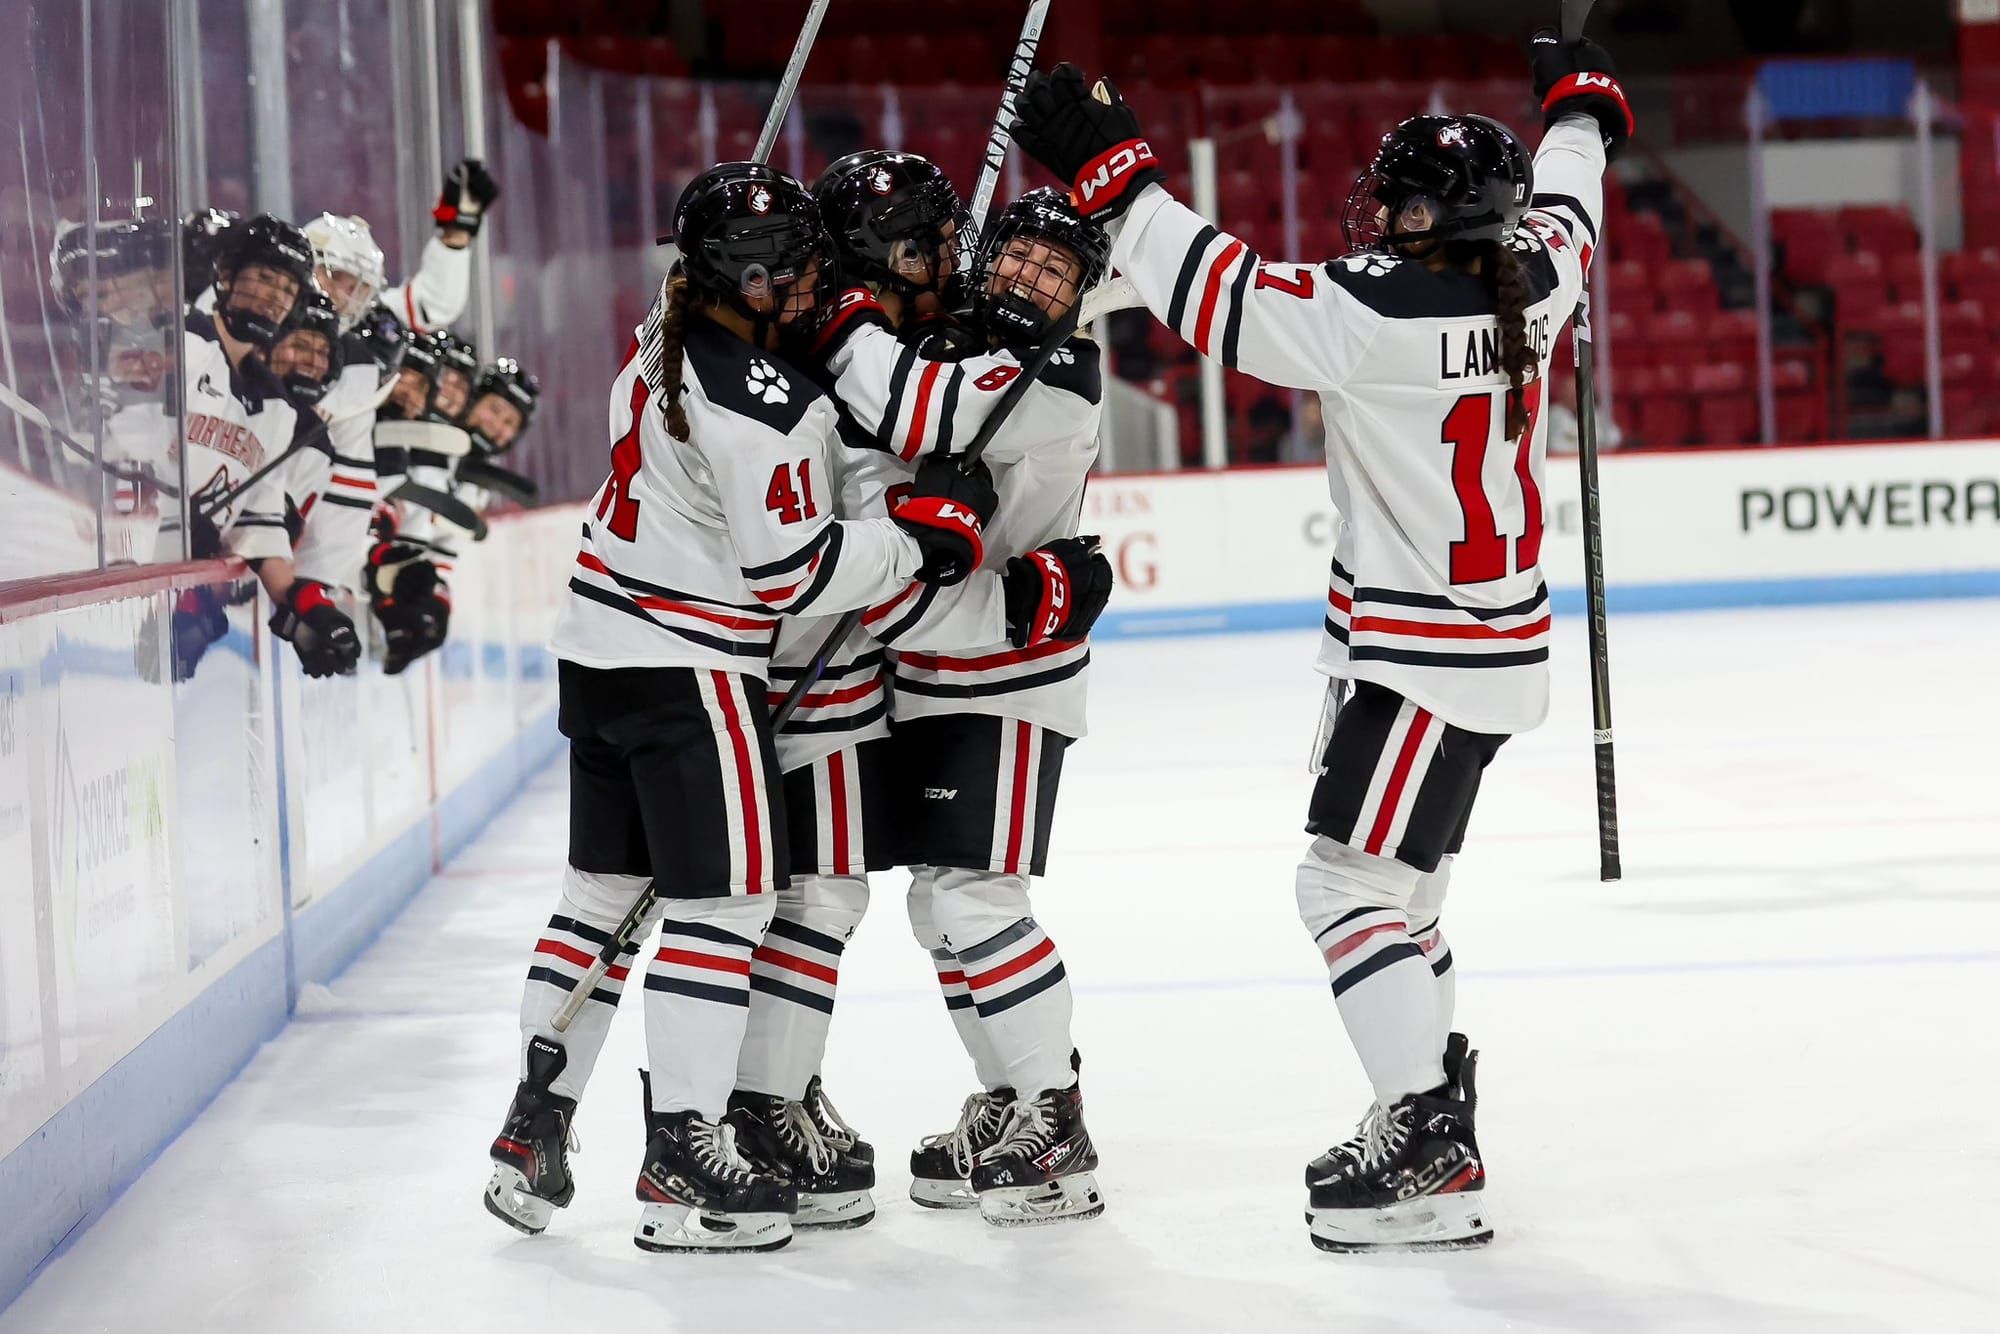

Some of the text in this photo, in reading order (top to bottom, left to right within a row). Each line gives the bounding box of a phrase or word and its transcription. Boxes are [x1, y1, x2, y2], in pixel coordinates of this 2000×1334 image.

[1081, 142, 1153, 202] CCM
[1515, 183, 1525, 200] 17
[1034, 205, 1081, 226] CCM
[1441, 314, 1549, 379] LANOIS
[765, 458, 817, 525] 41
[1441, 377, 1545, 586] 17
[1740, 479, 2000, 533] POWERA
[1587, 471, 1607, 635] JETSPEED
[1036, 551, 1064, 636] CCM
[82, 766, 130, 872] SOURCE
[534, 1040, 559, 1055] CCM
[535, 1138, 548, 1177] CCM
[651, 1160, 707, 1207] CCM
[756, 1223, 776, 1235] CCM
[838, 1197, 861, 1212] CCM
